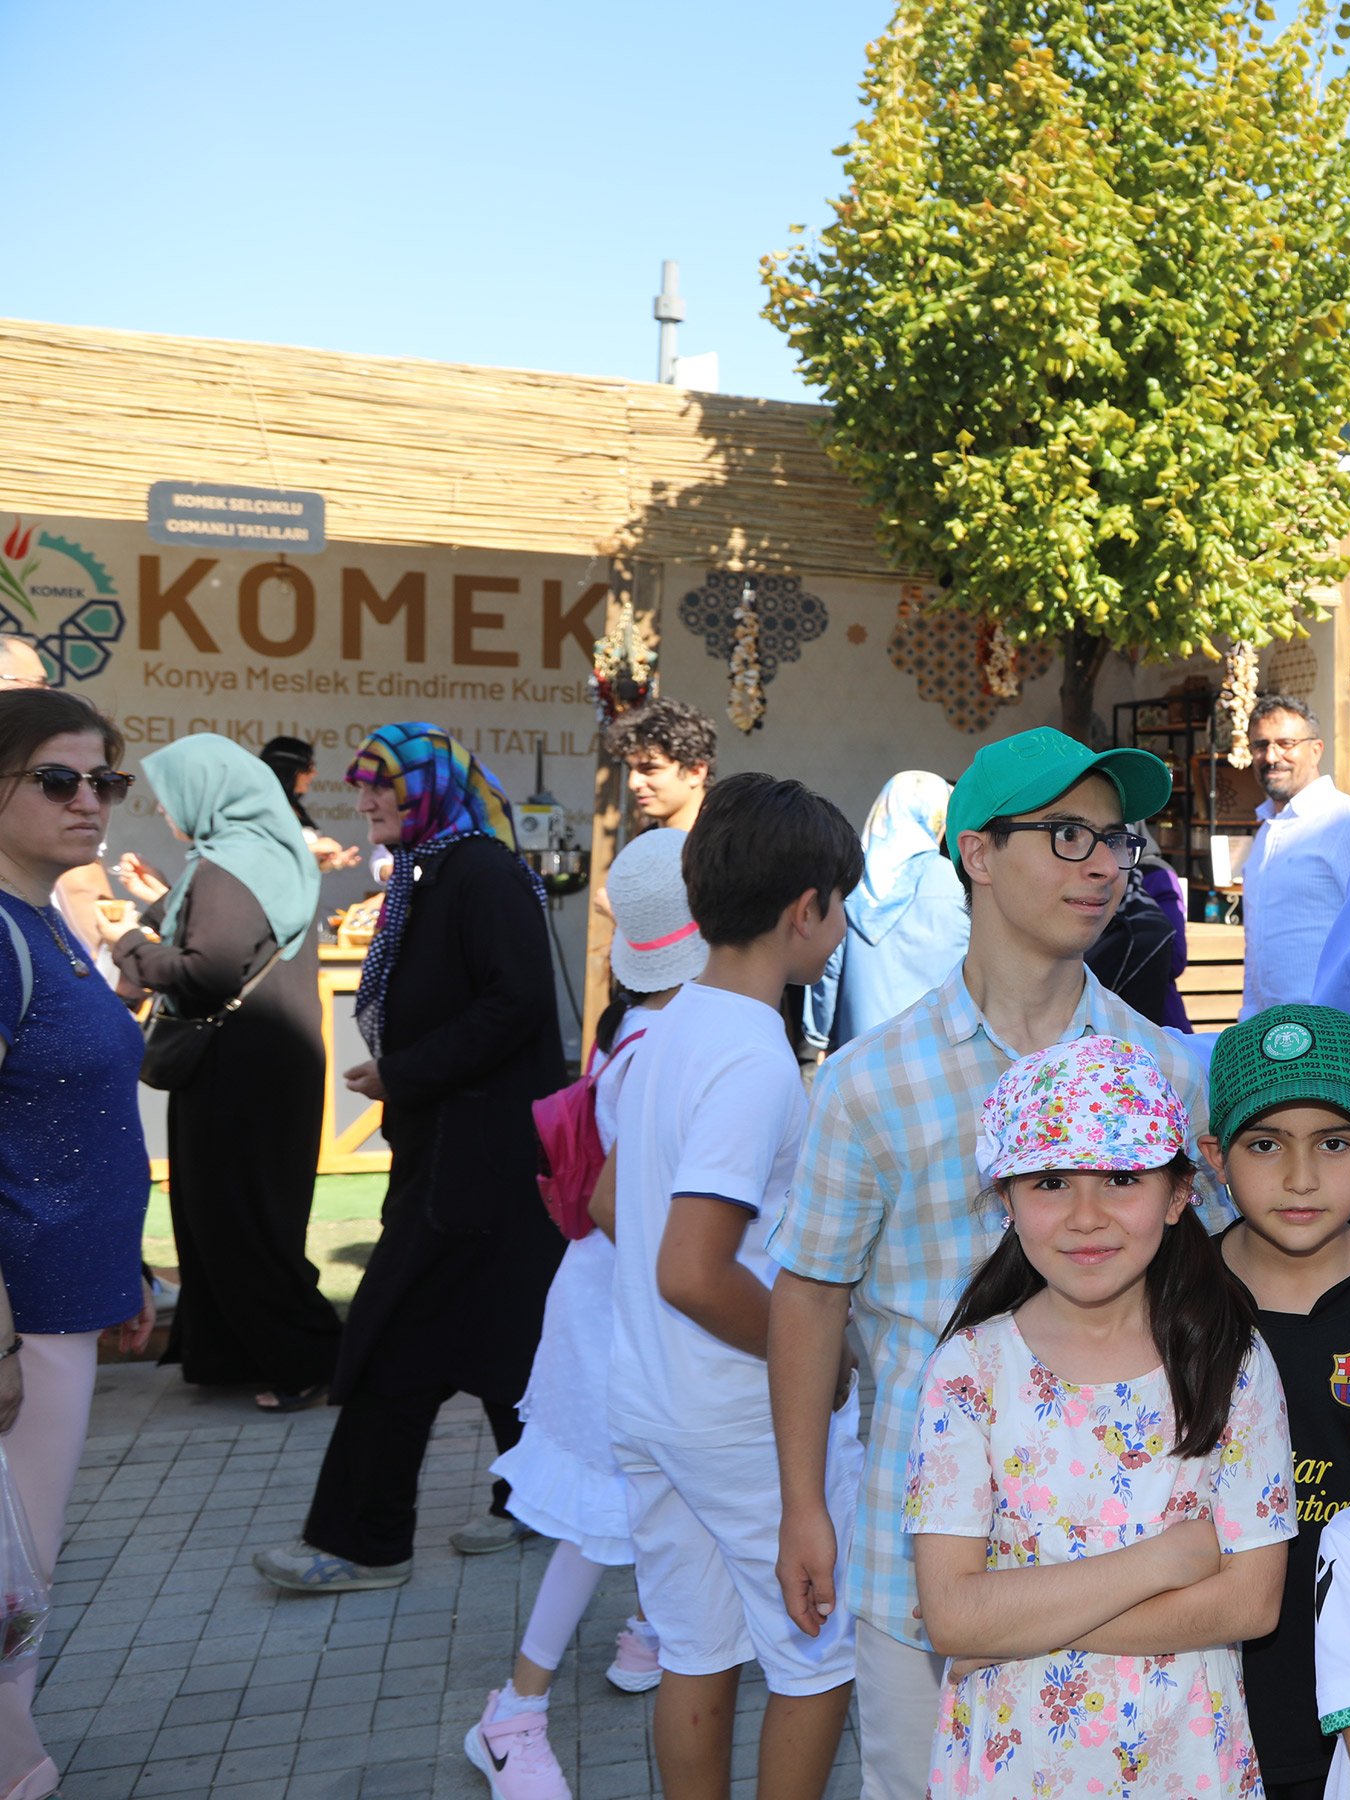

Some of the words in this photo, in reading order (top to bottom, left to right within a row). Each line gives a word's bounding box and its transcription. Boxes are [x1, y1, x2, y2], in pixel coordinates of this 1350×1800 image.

[30, 585, 86, 599] KOMEK
[137, 553, 613, 670] KOMEK
[143, 661, 238, 696] Konya
[246, 666, 350, 696] Meslek
[357, 670, 505, 701] Edindirme
[305, 728, 340, 749] ve
[1259, 1068, 1278, 1079] 1922
[1279, 1063, 1299, 1072] 1922
[1322, 1063, 1341, 1071] 1922
[1280, 1073, 1300, 1081] 1922
